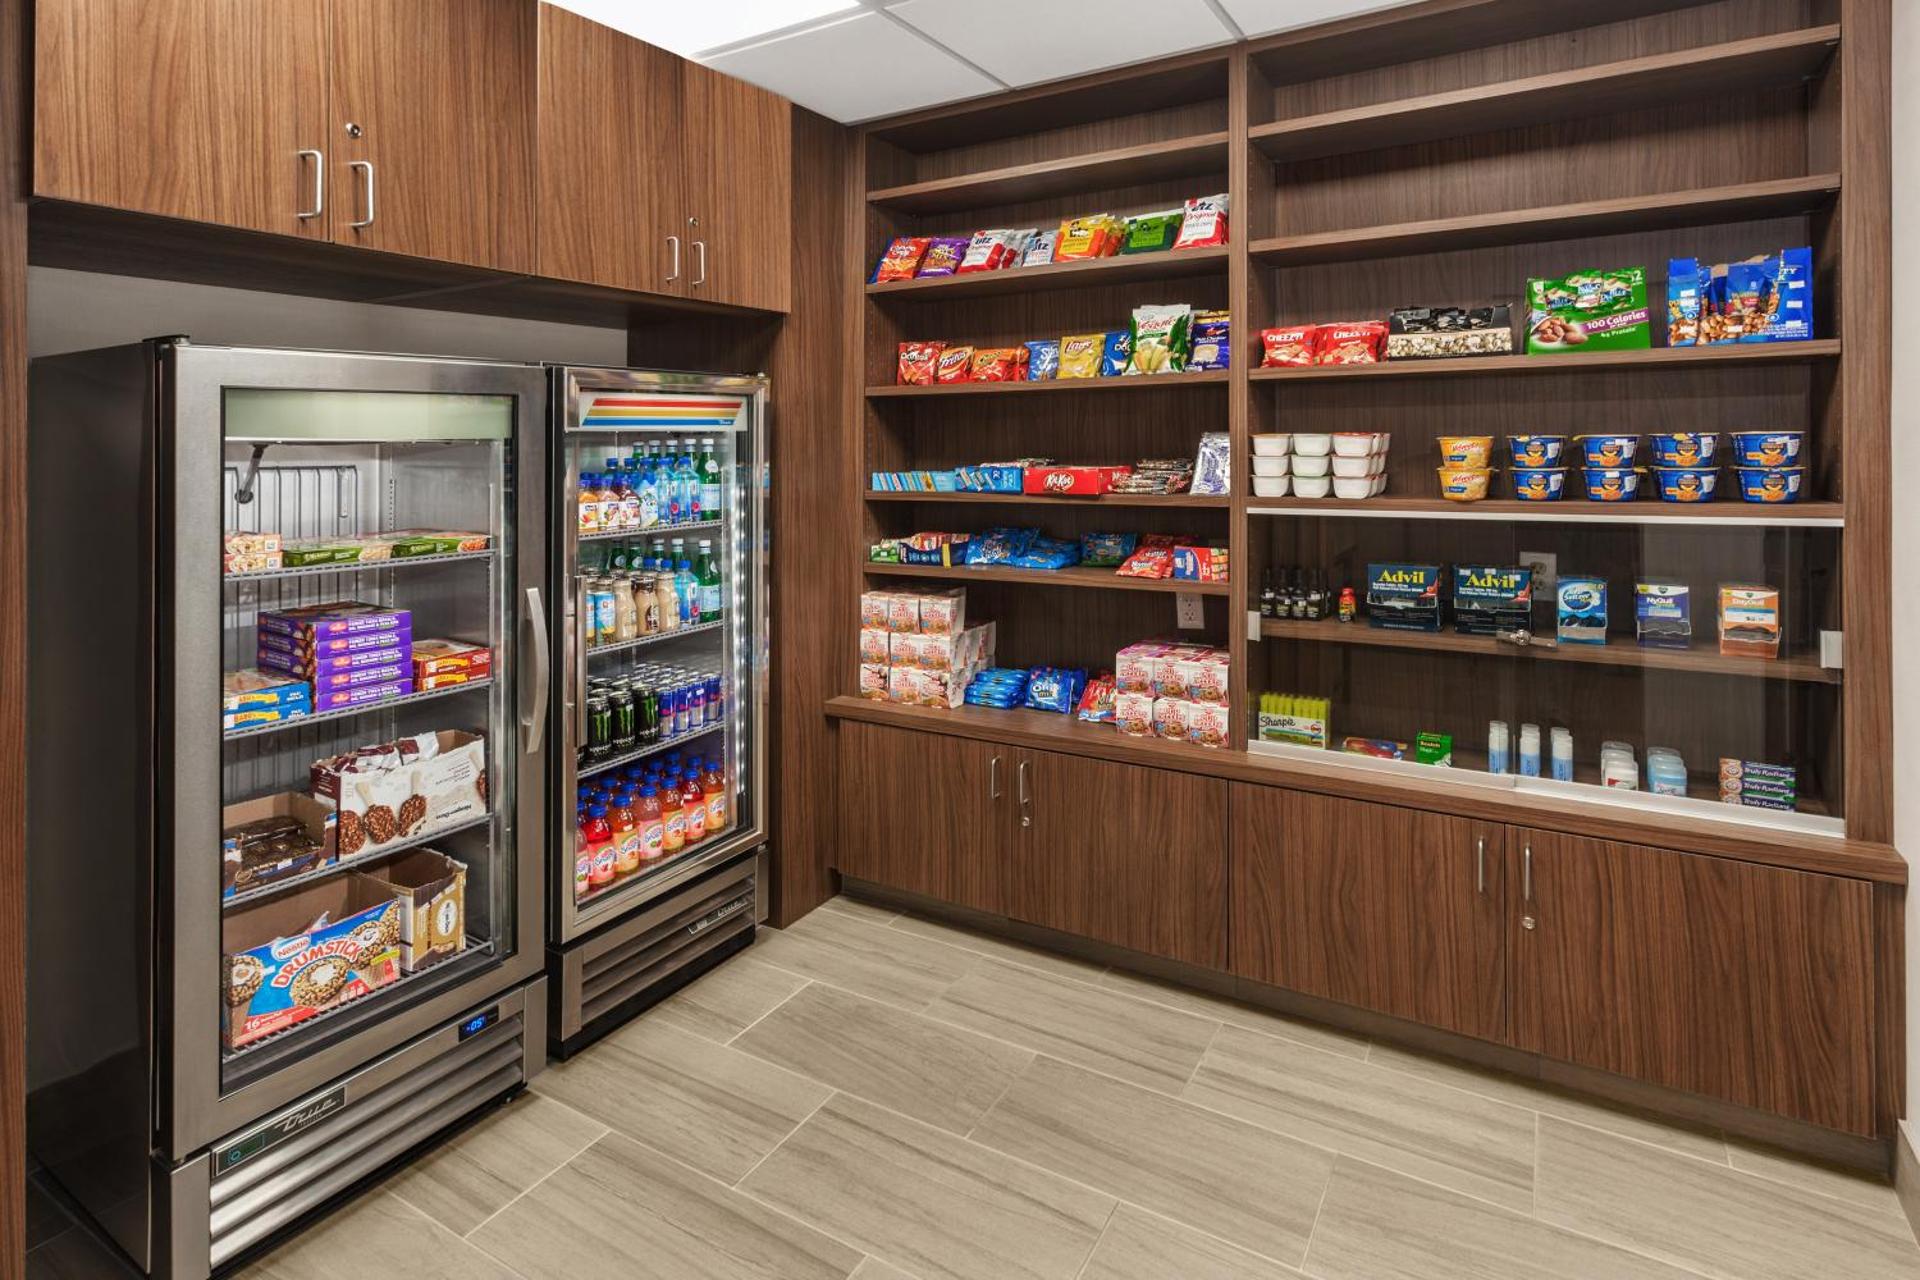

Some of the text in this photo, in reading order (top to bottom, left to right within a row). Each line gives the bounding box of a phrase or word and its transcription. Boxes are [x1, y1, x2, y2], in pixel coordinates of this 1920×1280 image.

[1587, 311, 1646, 330] 100 Calories
[1378, 569, 1424, 584] Advil
[1466, 573, 1515, 589] Advil
[1260, 716, 1296, 728] Sharpie
[1745, 767, 1761, 775] Truly
[272, 940, 363, 988] DRUMSTICK
[244, 1017, 261, 1031] 16
